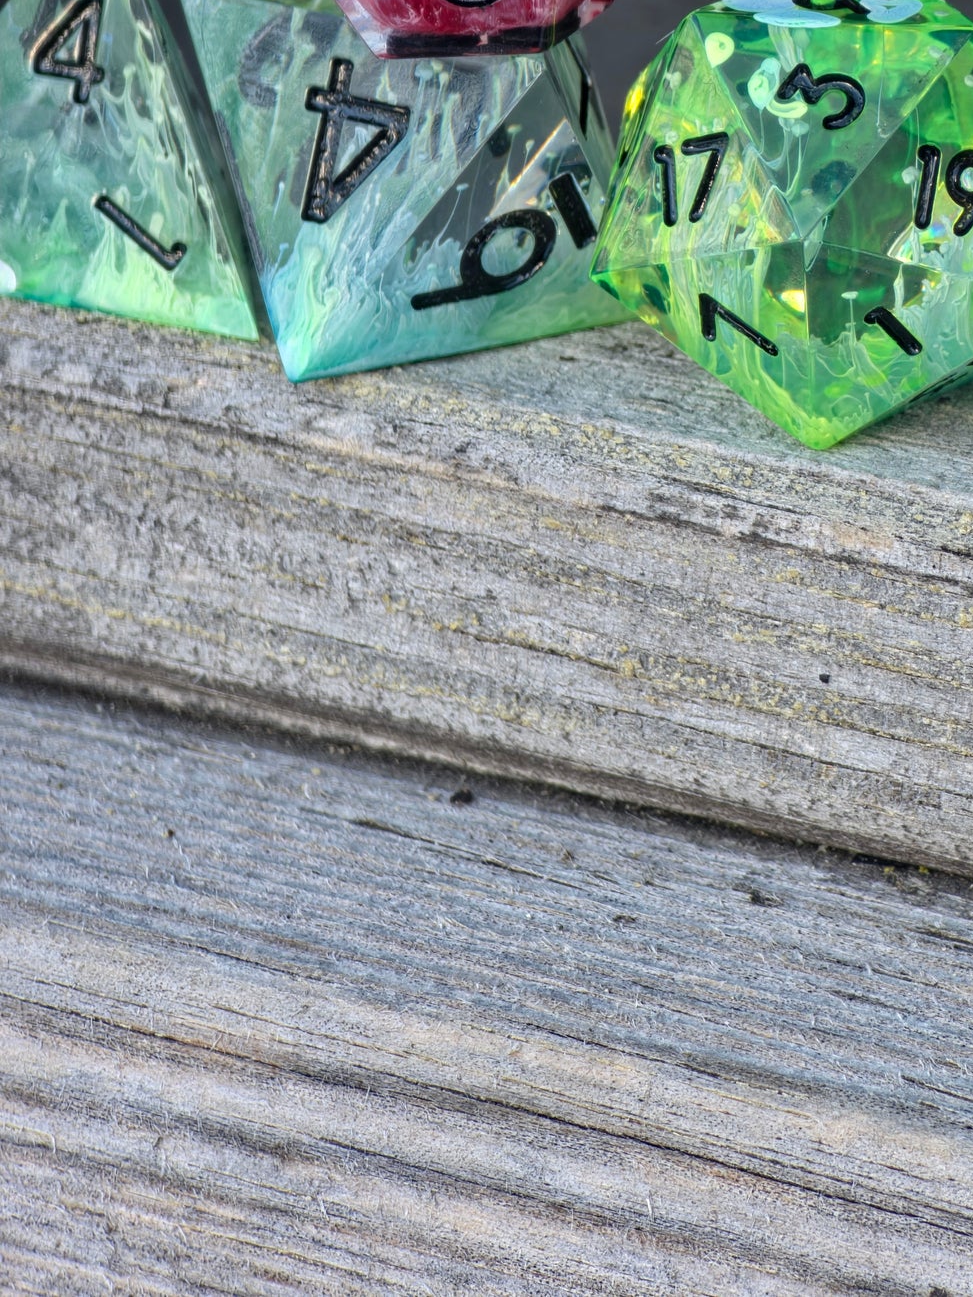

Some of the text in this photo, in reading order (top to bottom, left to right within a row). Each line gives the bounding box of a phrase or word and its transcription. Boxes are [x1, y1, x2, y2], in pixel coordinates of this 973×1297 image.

[302, 57, 411, 224] 4
[778, 62, 866, 130] 3
[653, 131, 730, 227] 17
